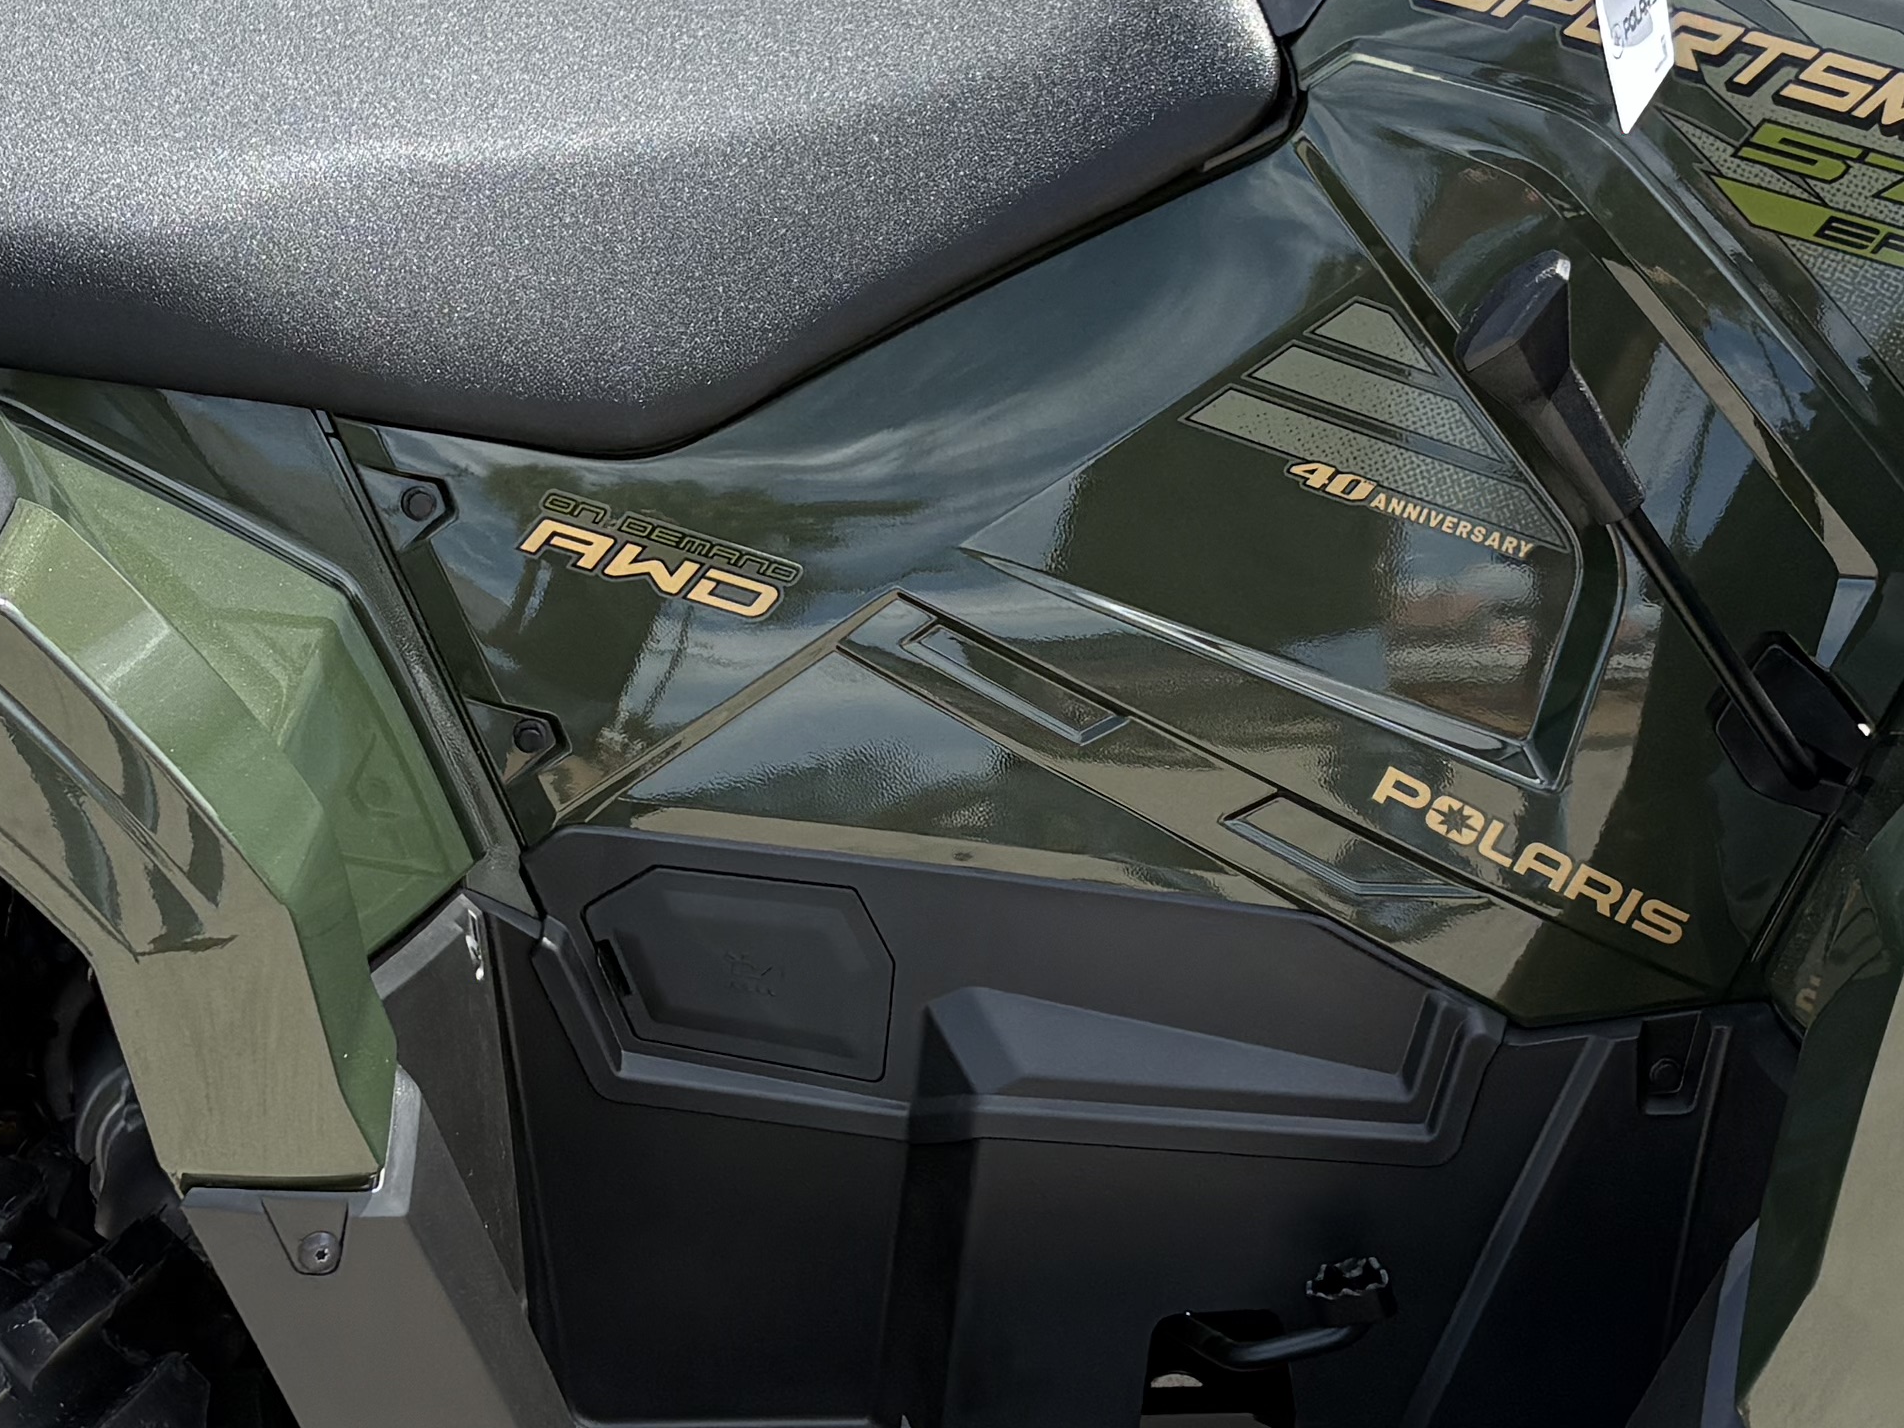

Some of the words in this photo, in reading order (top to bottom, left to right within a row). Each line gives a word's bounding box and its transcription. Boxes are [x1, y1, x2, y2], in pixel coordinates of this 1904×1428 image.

[518, 518, 786, 617] AWD
[543, 493, 602, 523] ON
[621, 514, 800, 584] DEMAND
[1370, 493, 1535, 559] ANNIVERSARY
[1371, 765, 1692, 945] POLARIS
